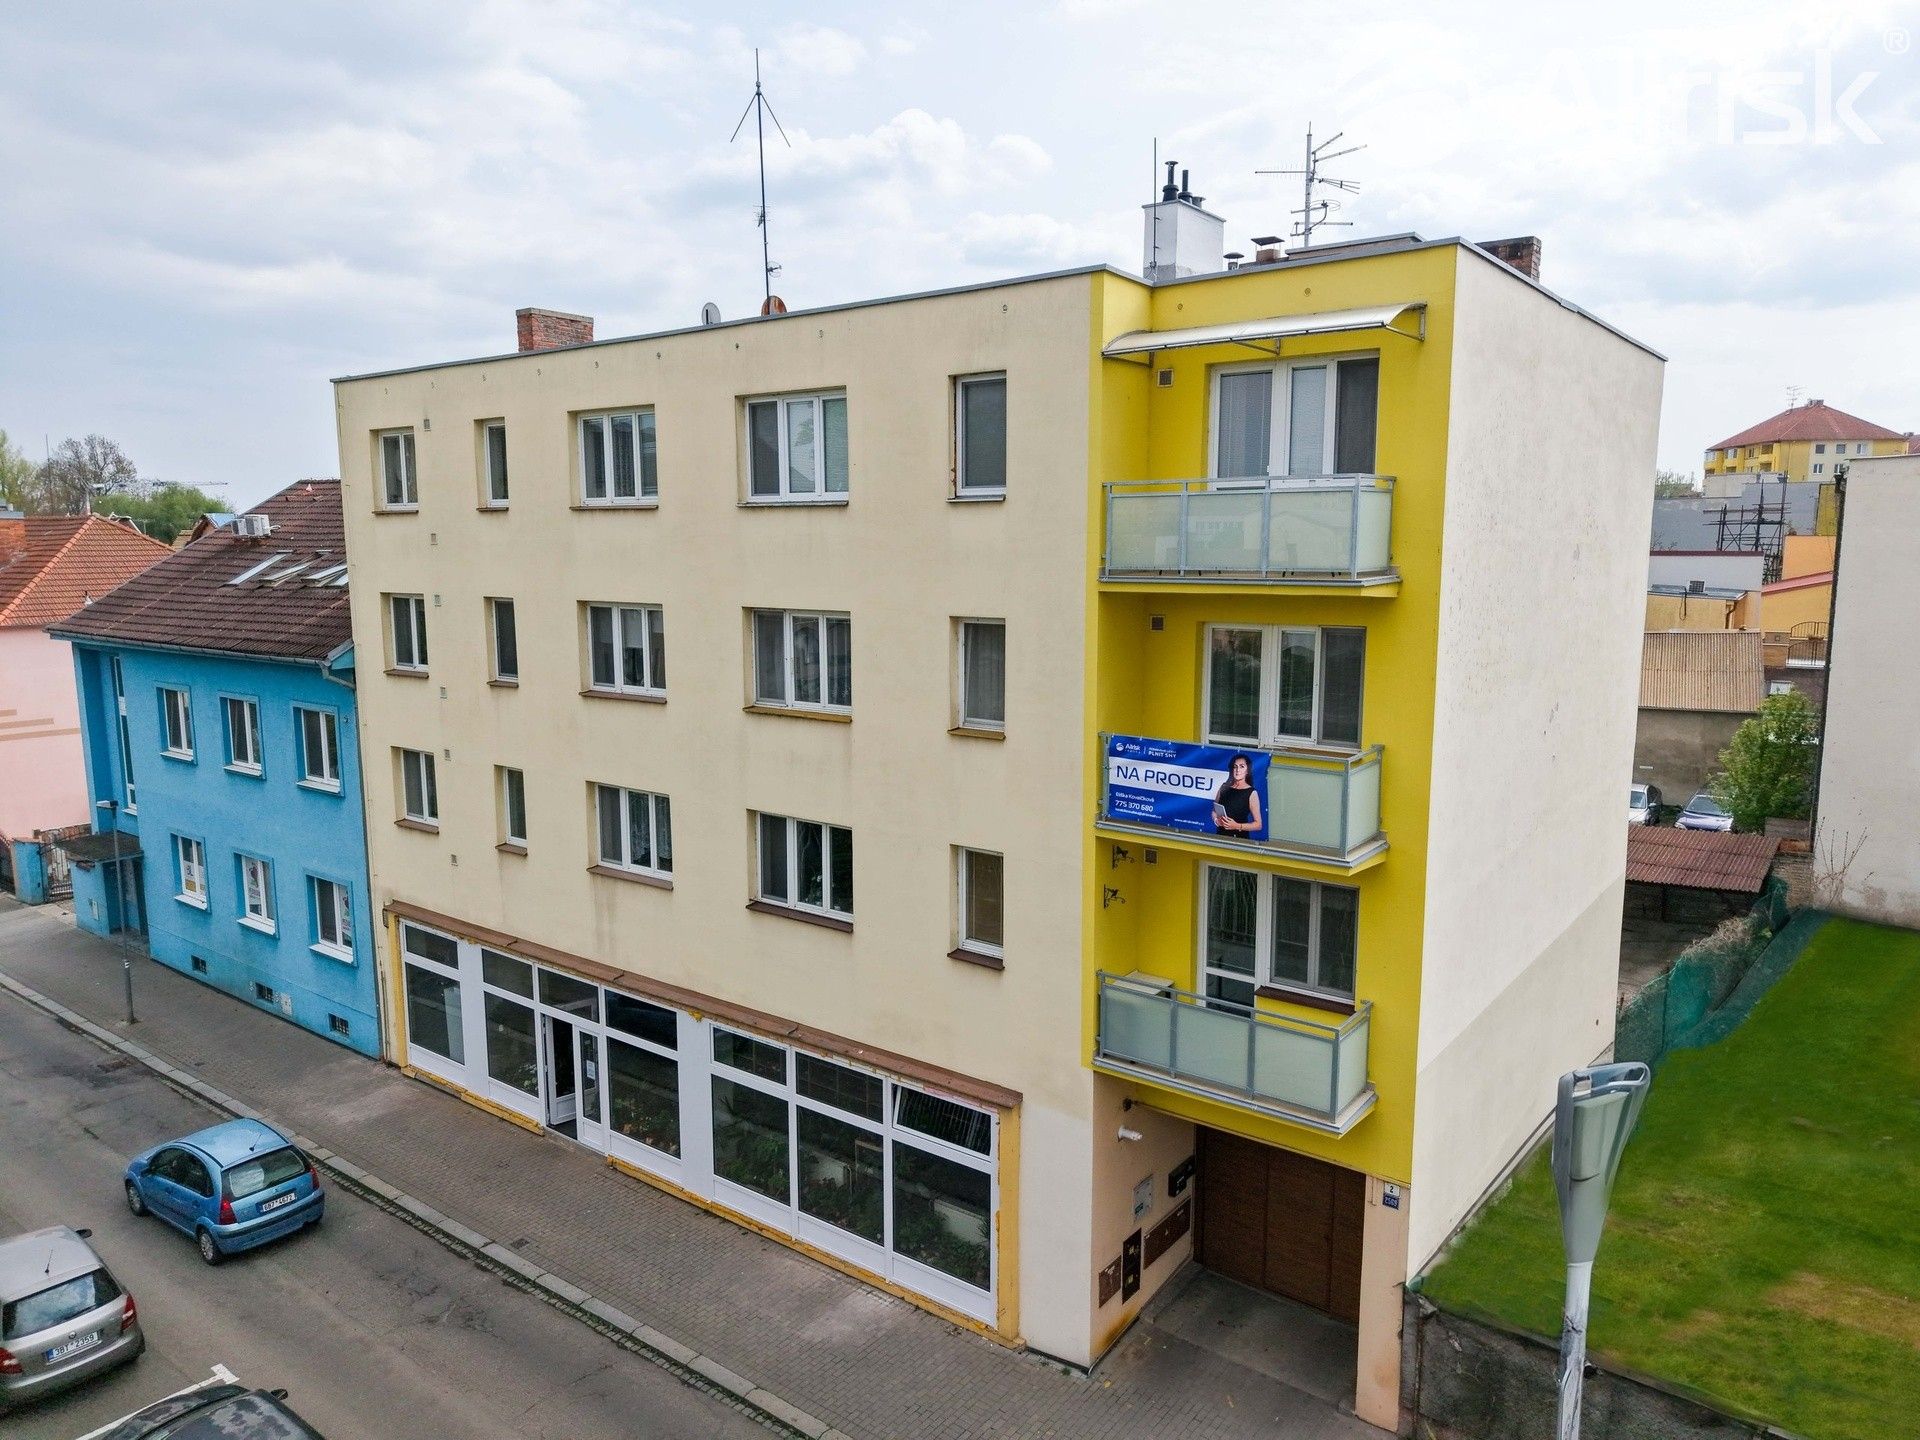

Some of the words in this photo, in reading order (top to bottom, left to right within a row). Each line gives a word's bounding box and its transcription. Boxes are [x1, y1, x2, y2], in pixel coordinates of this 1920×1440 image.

[1116, 765, 1140, 781] NA
[1144, 769, 1214, 791] PRODEJ
[1389, 1185, 1394, 1194] 2
